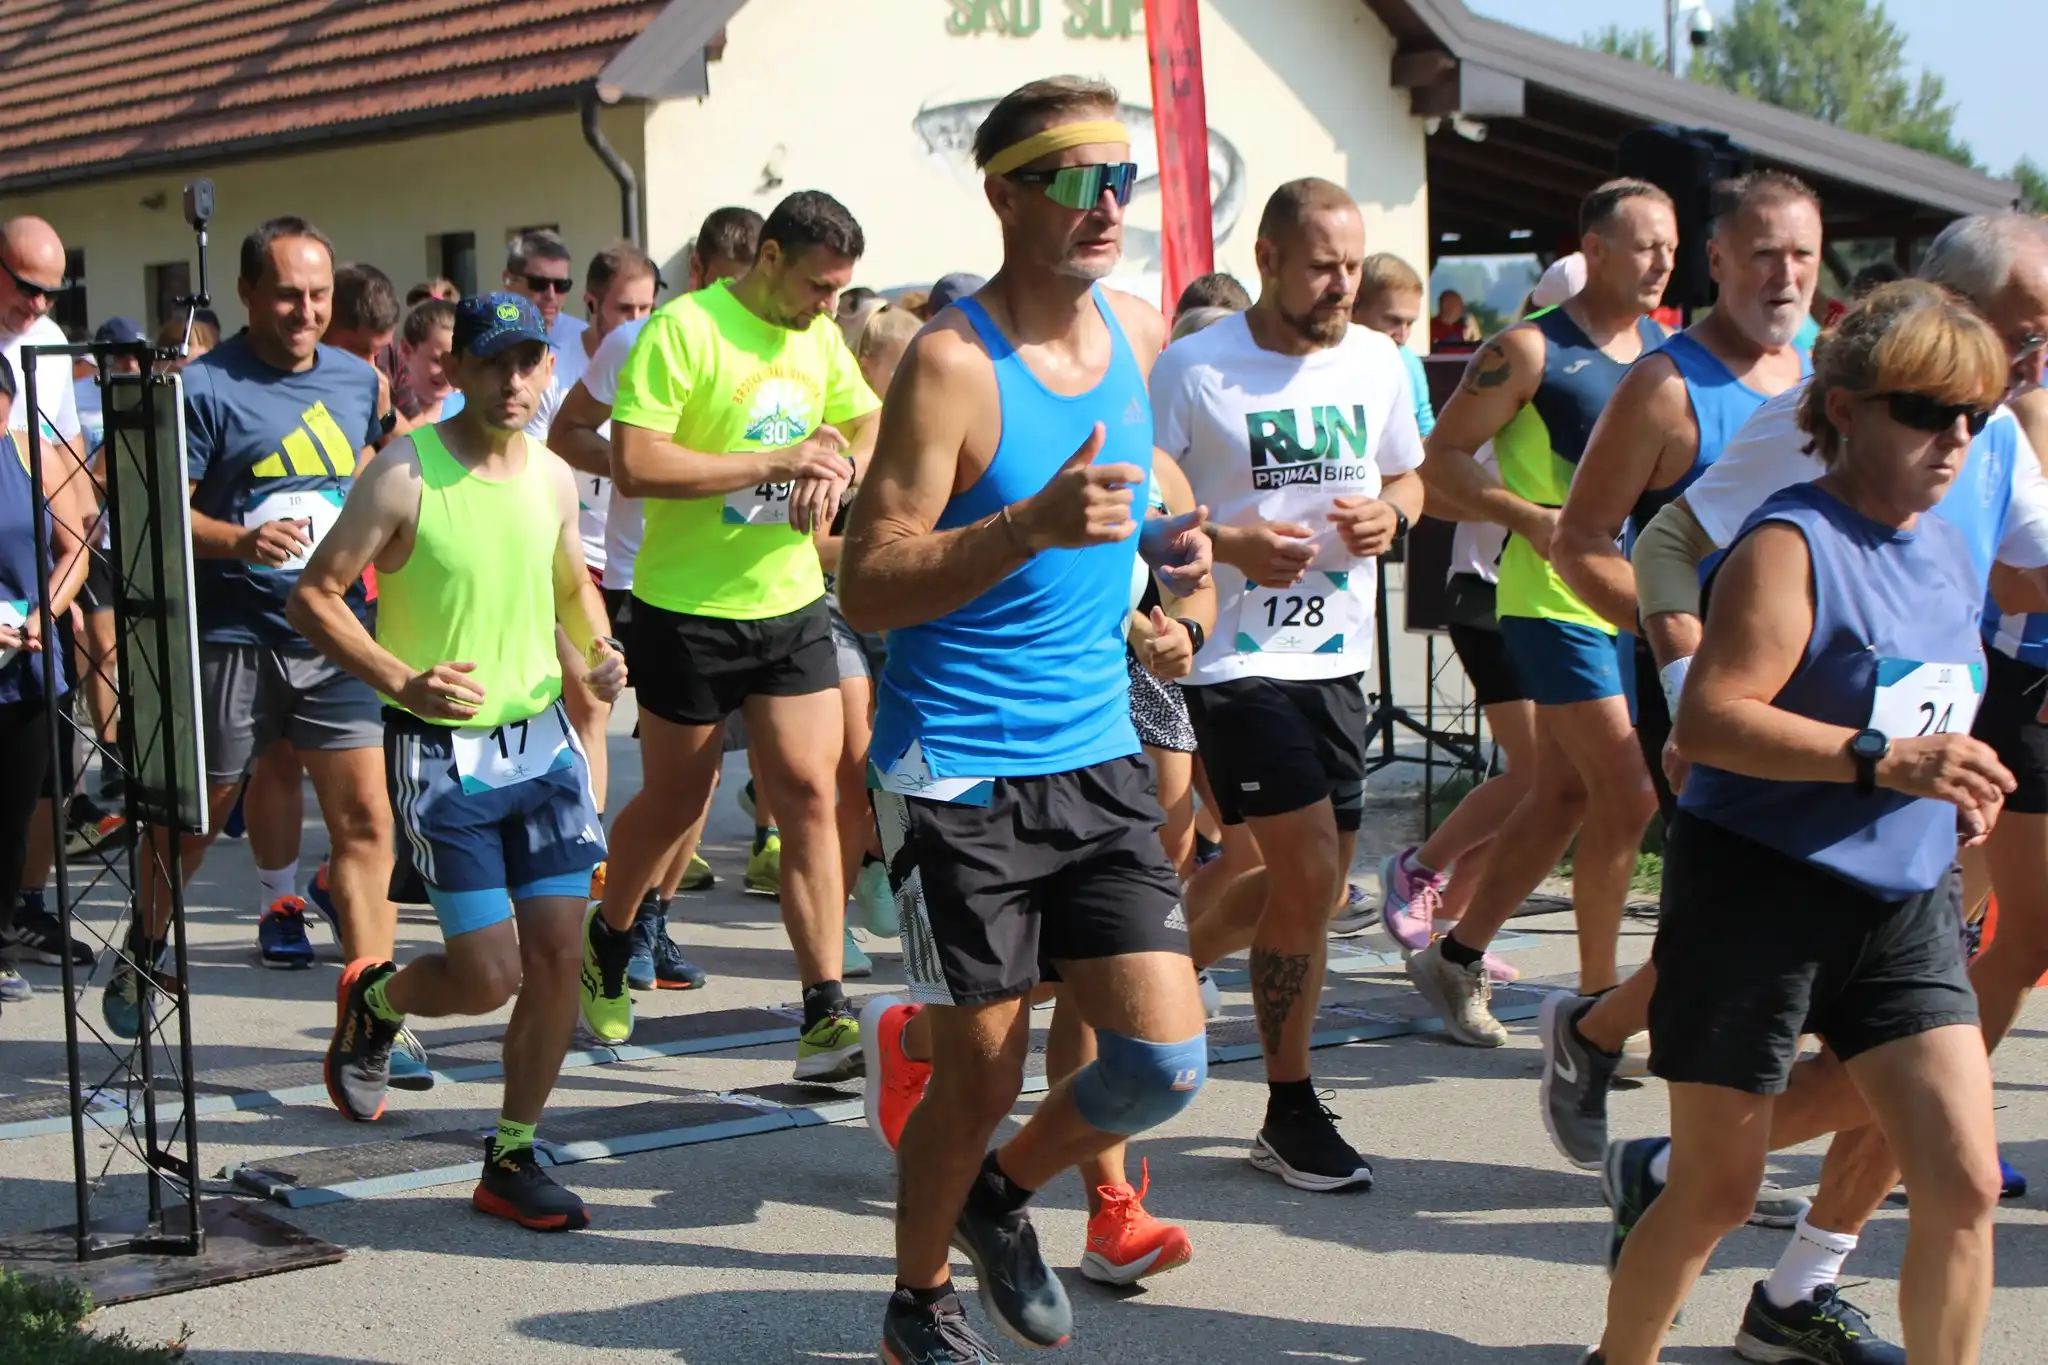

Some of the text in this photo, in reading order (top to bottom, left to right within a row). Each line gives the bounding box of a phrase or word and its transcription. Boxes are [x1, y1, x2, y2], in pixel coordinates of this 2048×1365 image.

[1245, 404, 1368, 468] RUN
[1255, 465, 1366, 488] PRIMA BIRO
[1263, 596, 1325, 628] 128
[1917, 702, 1954, 737] 24
[489, 719, 528, 760] 17
